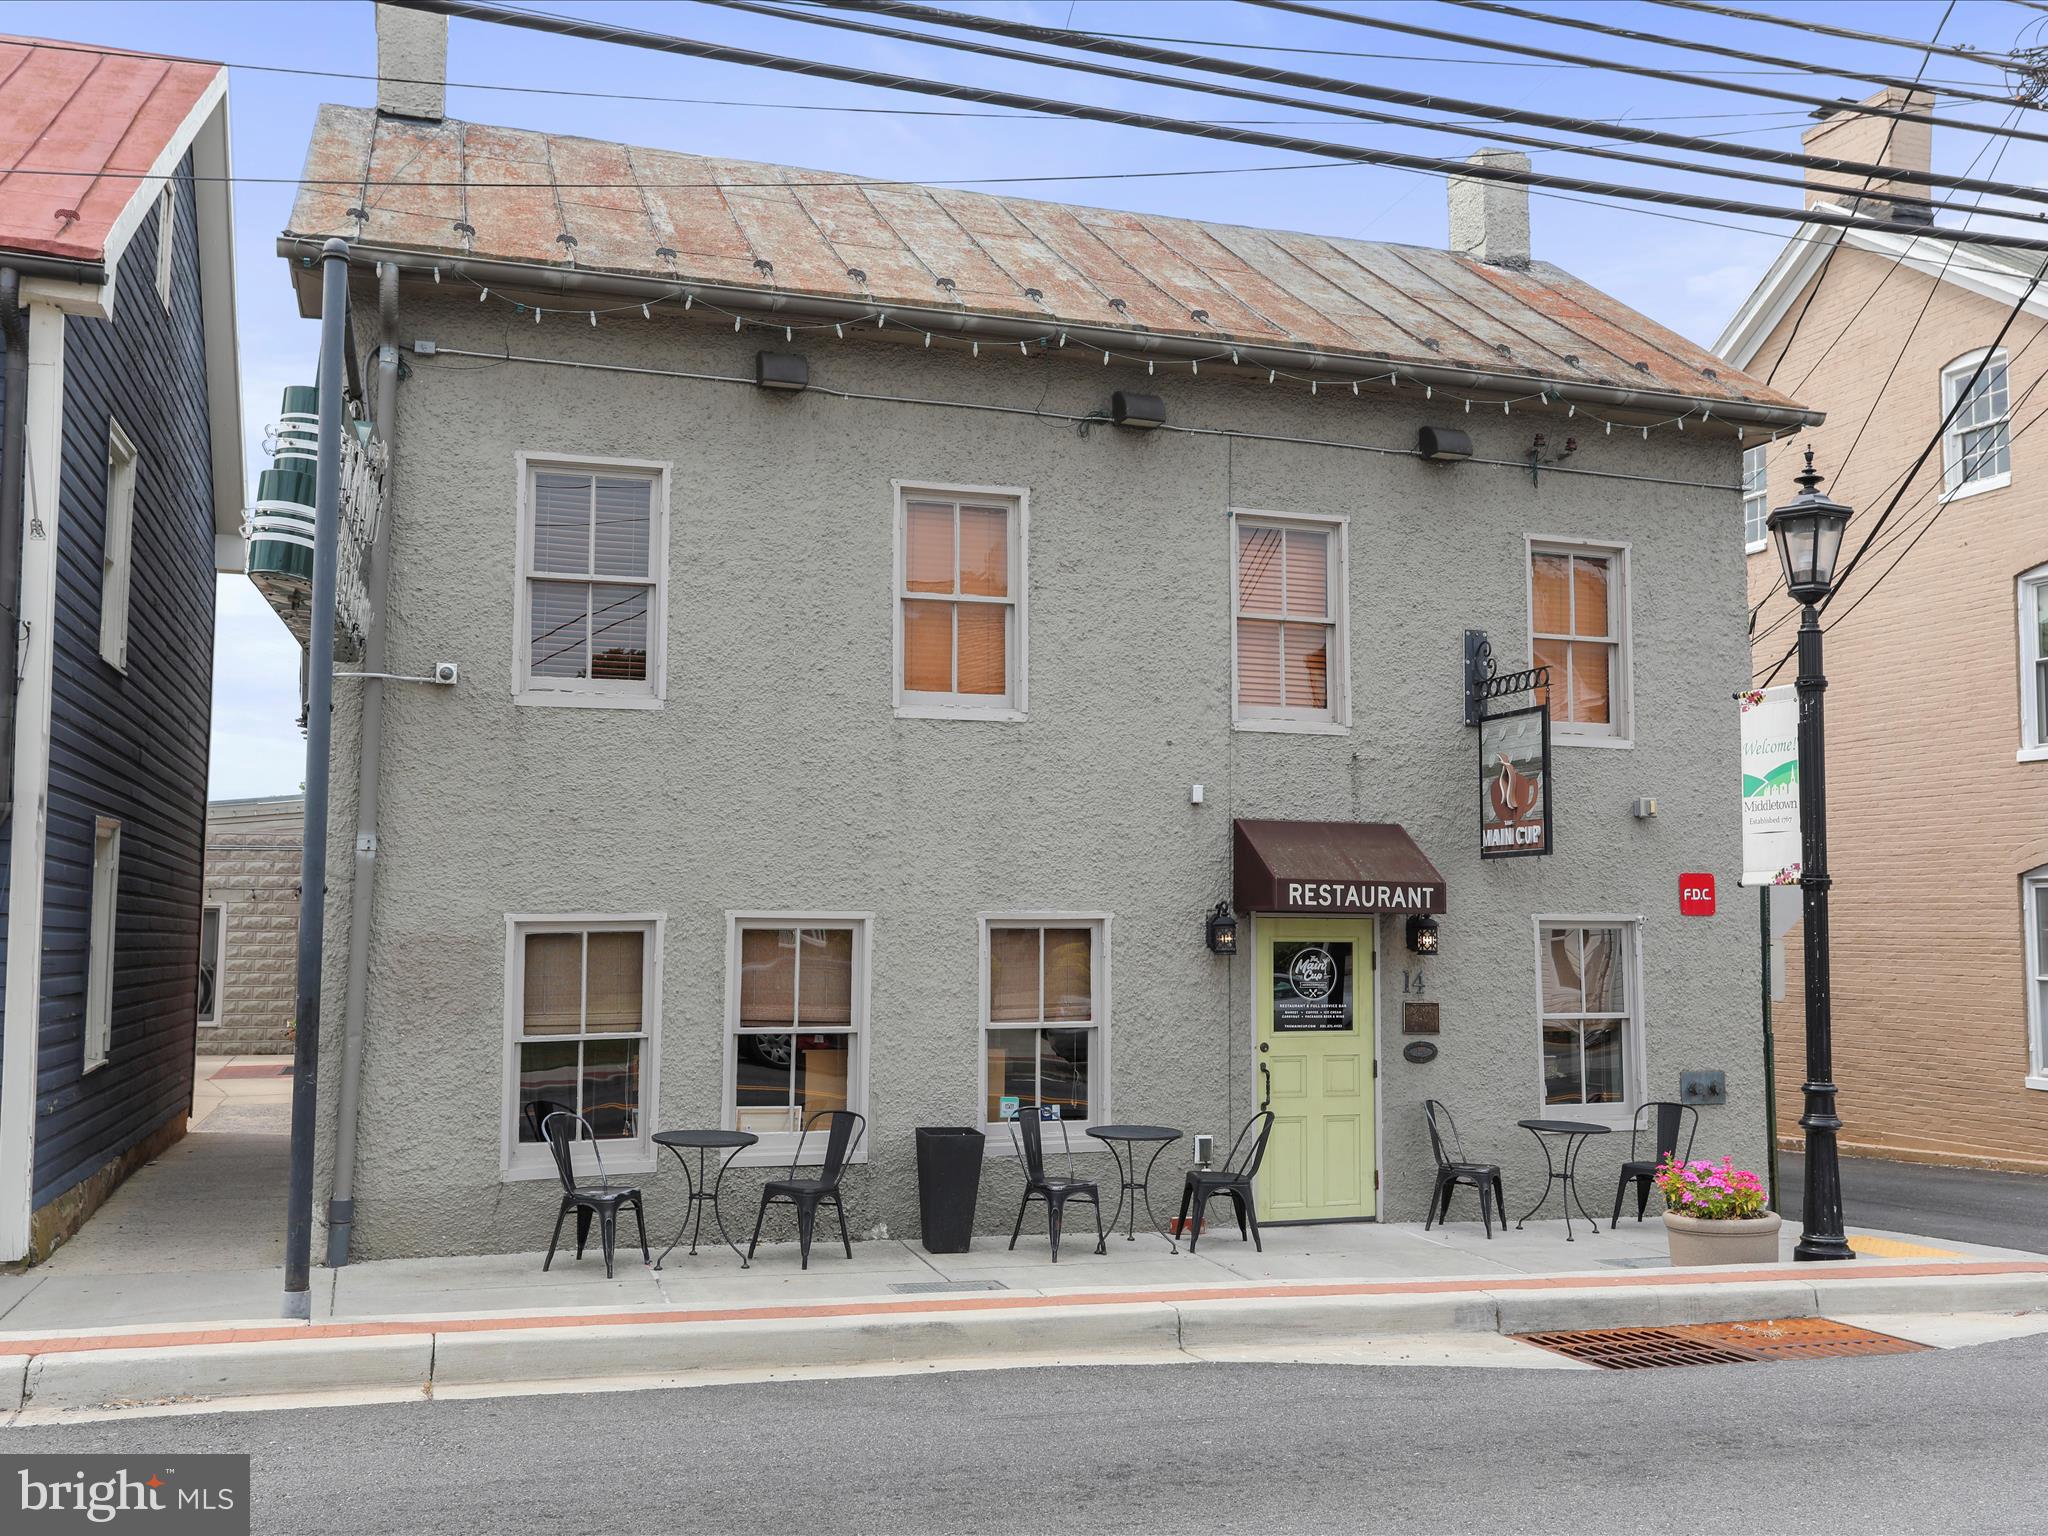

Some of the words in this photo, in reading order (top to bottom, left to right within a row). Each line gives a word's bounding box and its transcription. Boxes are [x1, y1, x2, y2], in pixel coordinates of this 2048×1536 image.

[1744, 737, 1797, 756] Welcome!
[1744, 800, 1798, 812] Middletown
[1749, 815, 1780, 825] Established
[1483, 827, 1515, 847] MAIN
[1516, 825, 1541, 845] CUP
[1289, 883, 1434, 909] RESTAURANT
[1295, 959, 1327, 974] Main
[1304, 969, 1323, 981] Cup
[1402, 970, 1425, 994] 14
